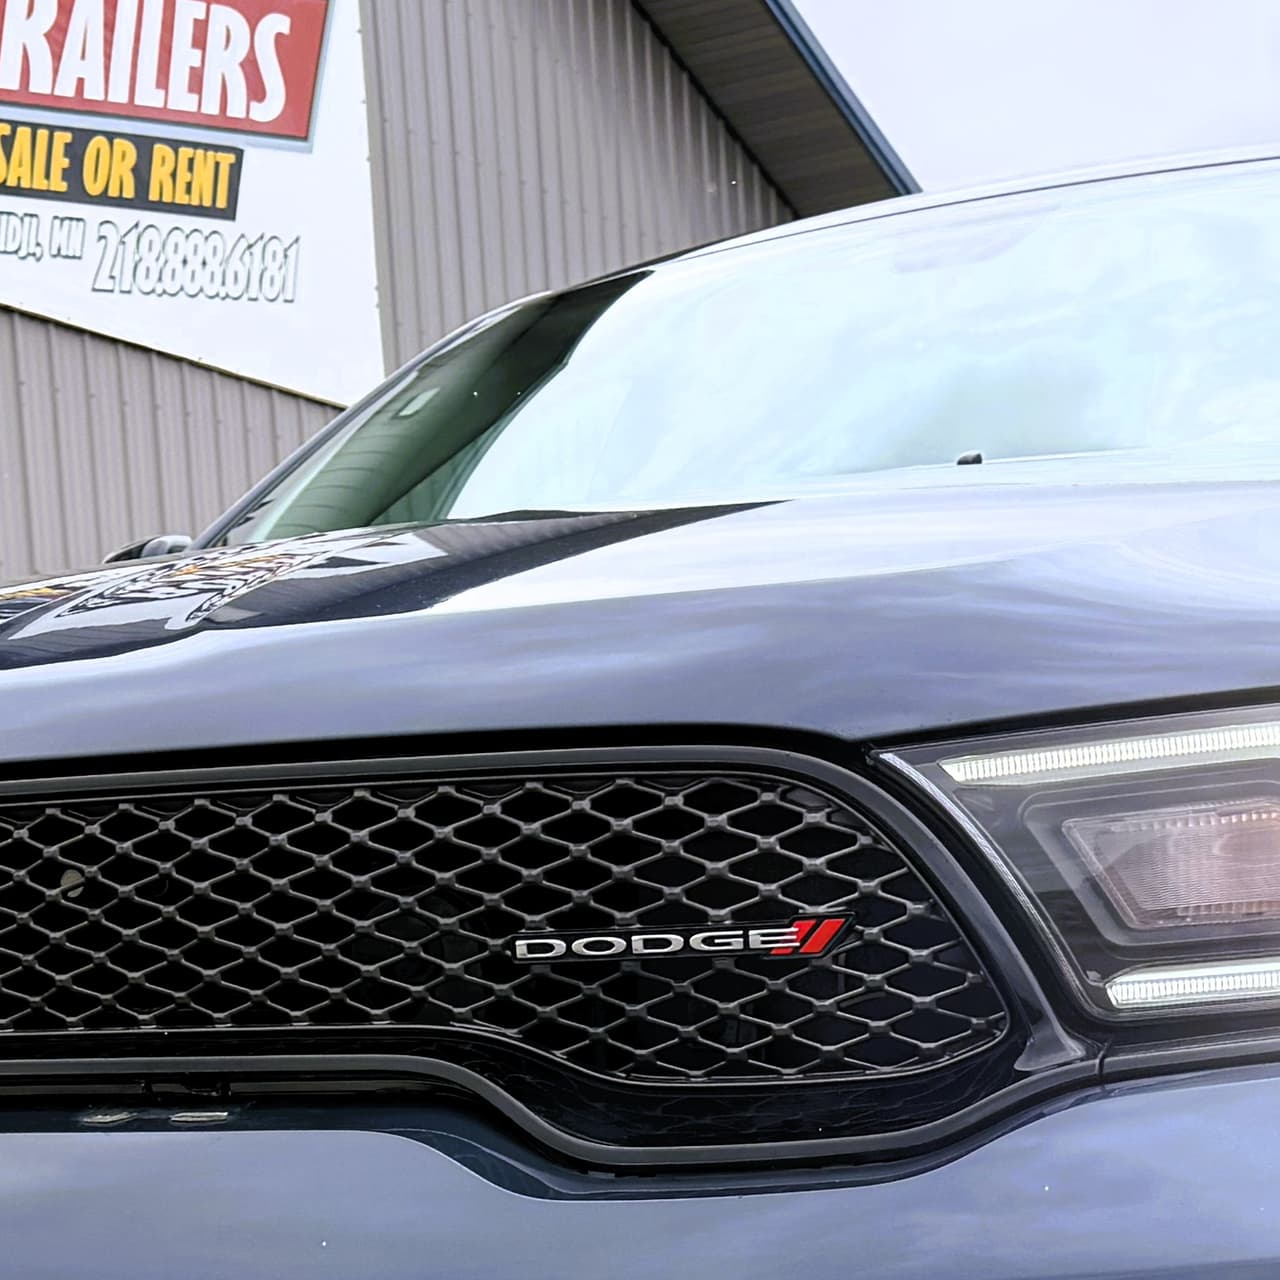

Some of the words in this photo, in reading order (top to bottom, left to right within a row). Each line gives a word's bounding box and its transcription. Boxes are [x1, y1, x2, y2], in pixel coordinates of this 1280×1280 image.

[82, 136, 138, 199] OR
[148, 143, 236, 209] RENT
[50, 215, 86, 260] MN
[91, 219, 302, 302] 218.888.6181
[515, 926, 801, 959] DODGE
